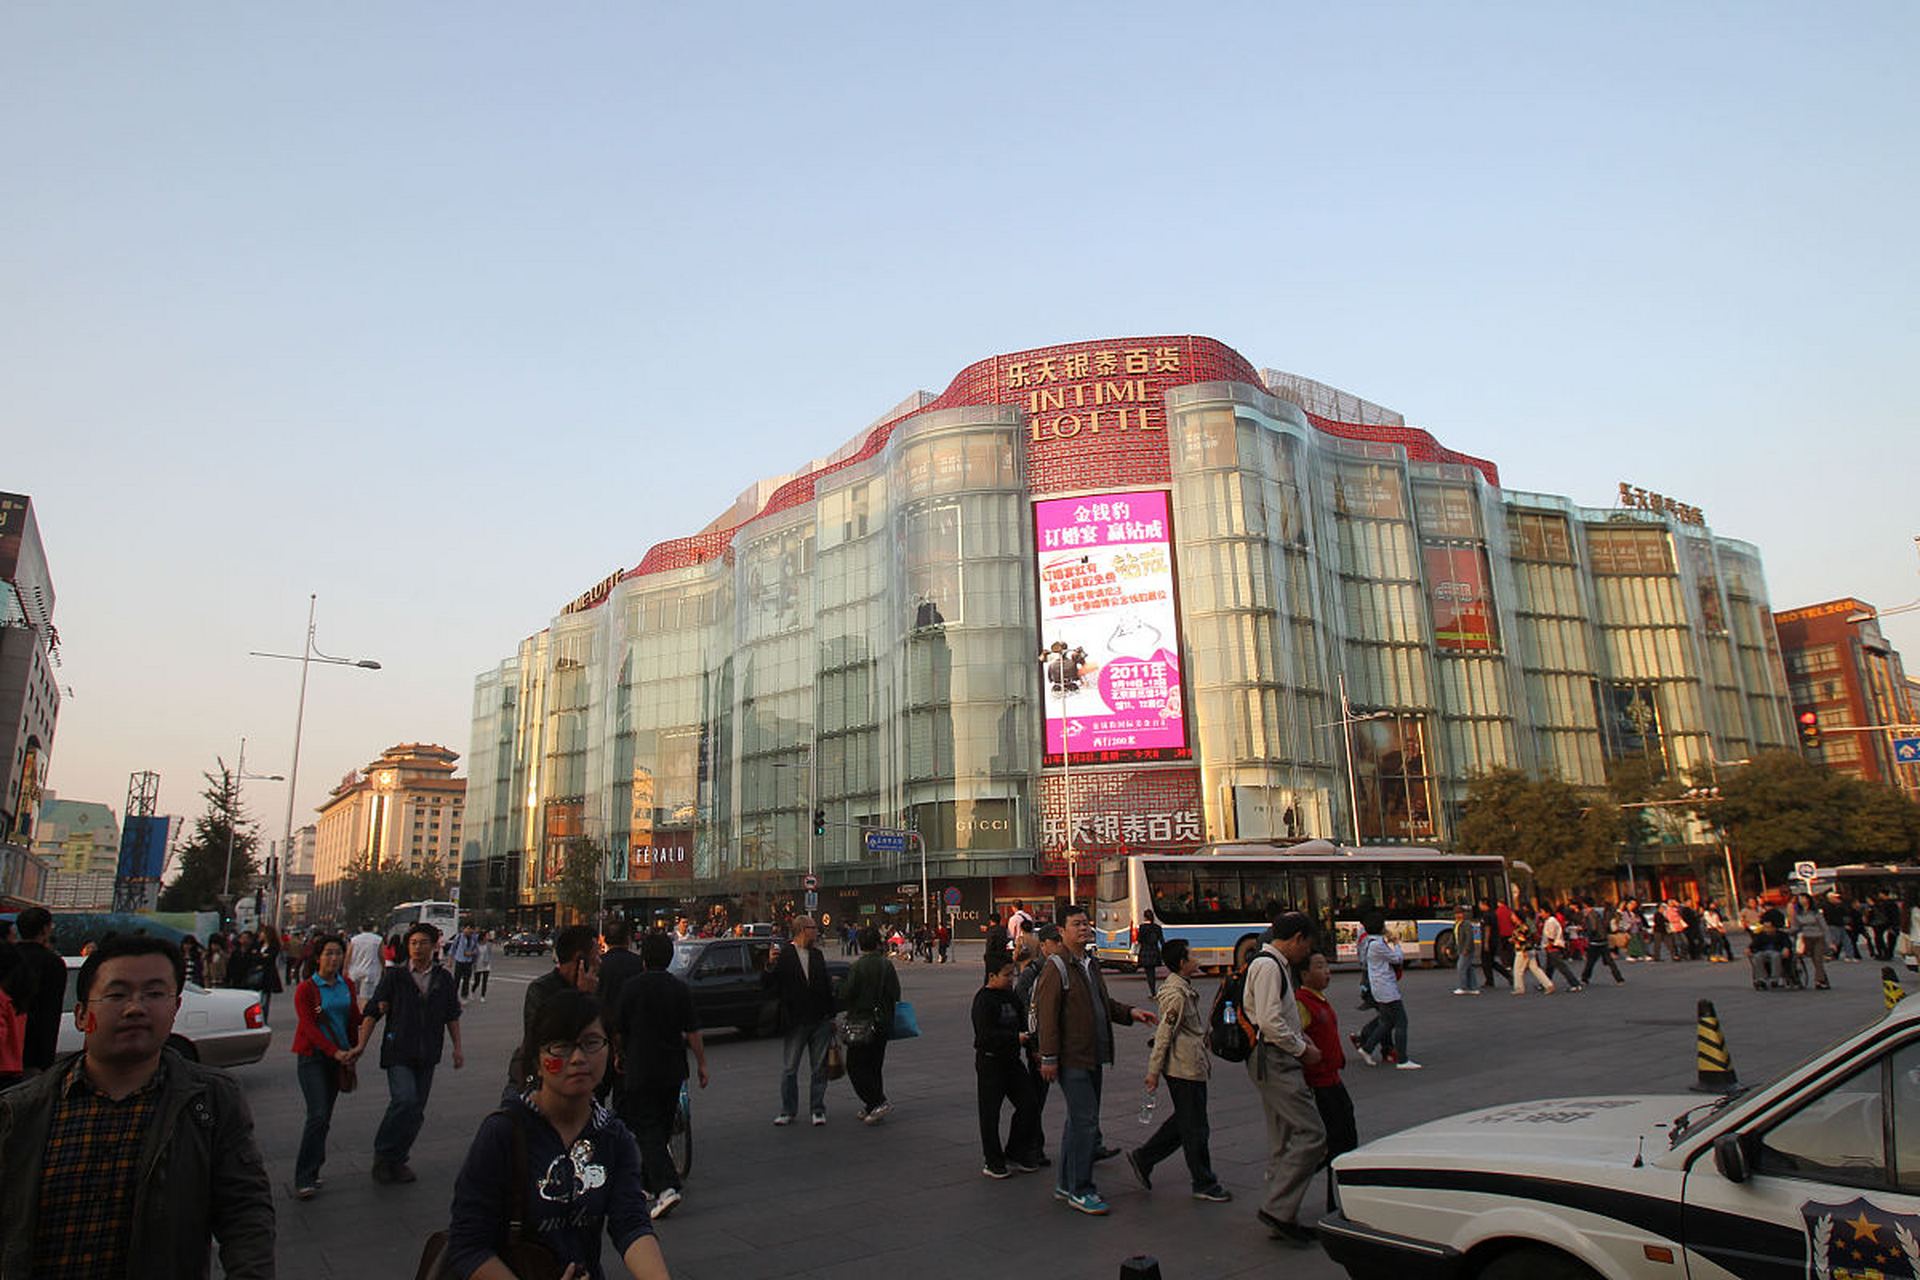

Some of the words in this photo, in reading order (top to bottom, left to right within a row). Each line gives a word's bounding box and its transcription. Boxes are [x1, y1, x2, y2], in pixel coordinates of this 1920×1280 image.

[1008, 346, 1181, 388] 乐天银泰百货
[1030, 379, 1160, 414] INTIME
[1032, 407, 1163, 441] LOTTE
[1073, 502, 1130, 523] 金钱豹
[1044, 526, 1099, 547] 订婚宴
[1107, 520, 1163, 541] 赢钻戒
[957, 819, 1010, 832] GUCCI
[1042, 810, 1201, 846] 乐天银泰百货
[951, 910, 979, 920] UCCI
